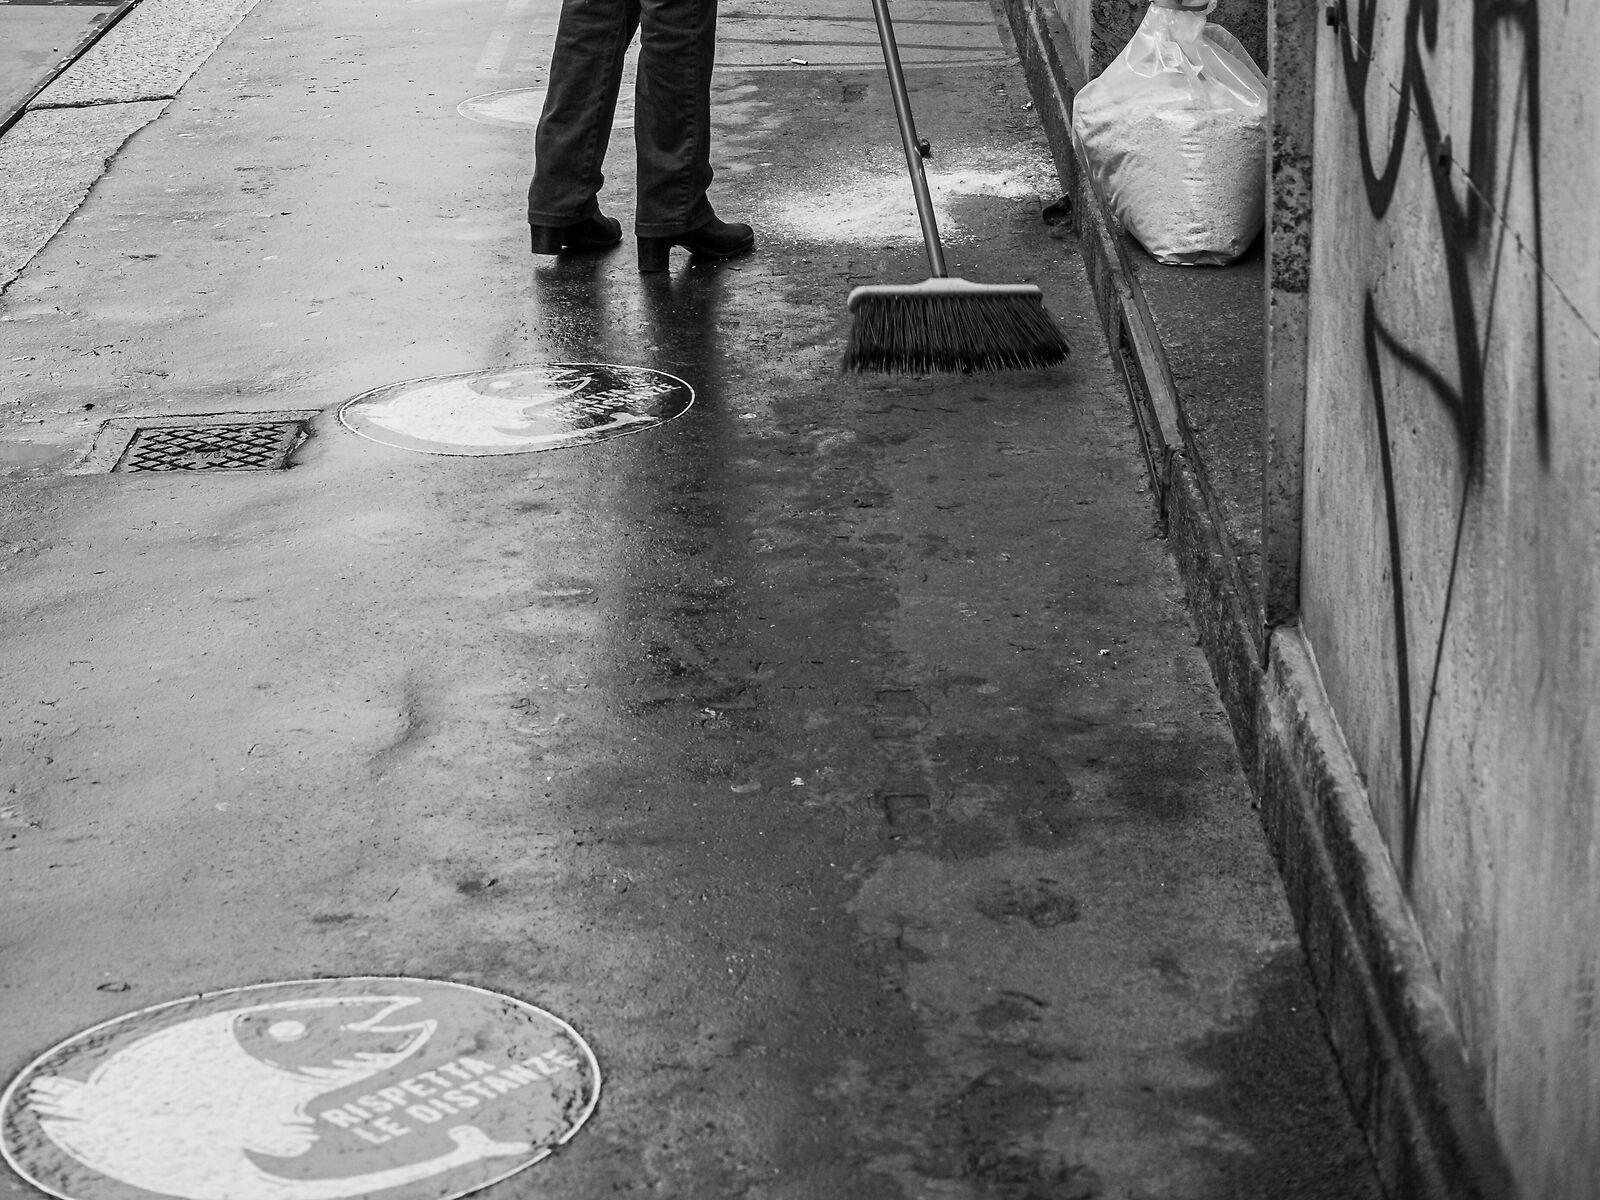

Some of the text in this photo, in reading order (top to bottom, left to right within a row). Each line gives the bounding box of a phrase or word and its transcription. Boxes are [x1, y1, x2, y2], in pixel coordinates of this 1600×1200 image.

[319, 1056, 496, 1128] RISPETTA
[353, 1049, 579, 1145] LE DISTANZE
